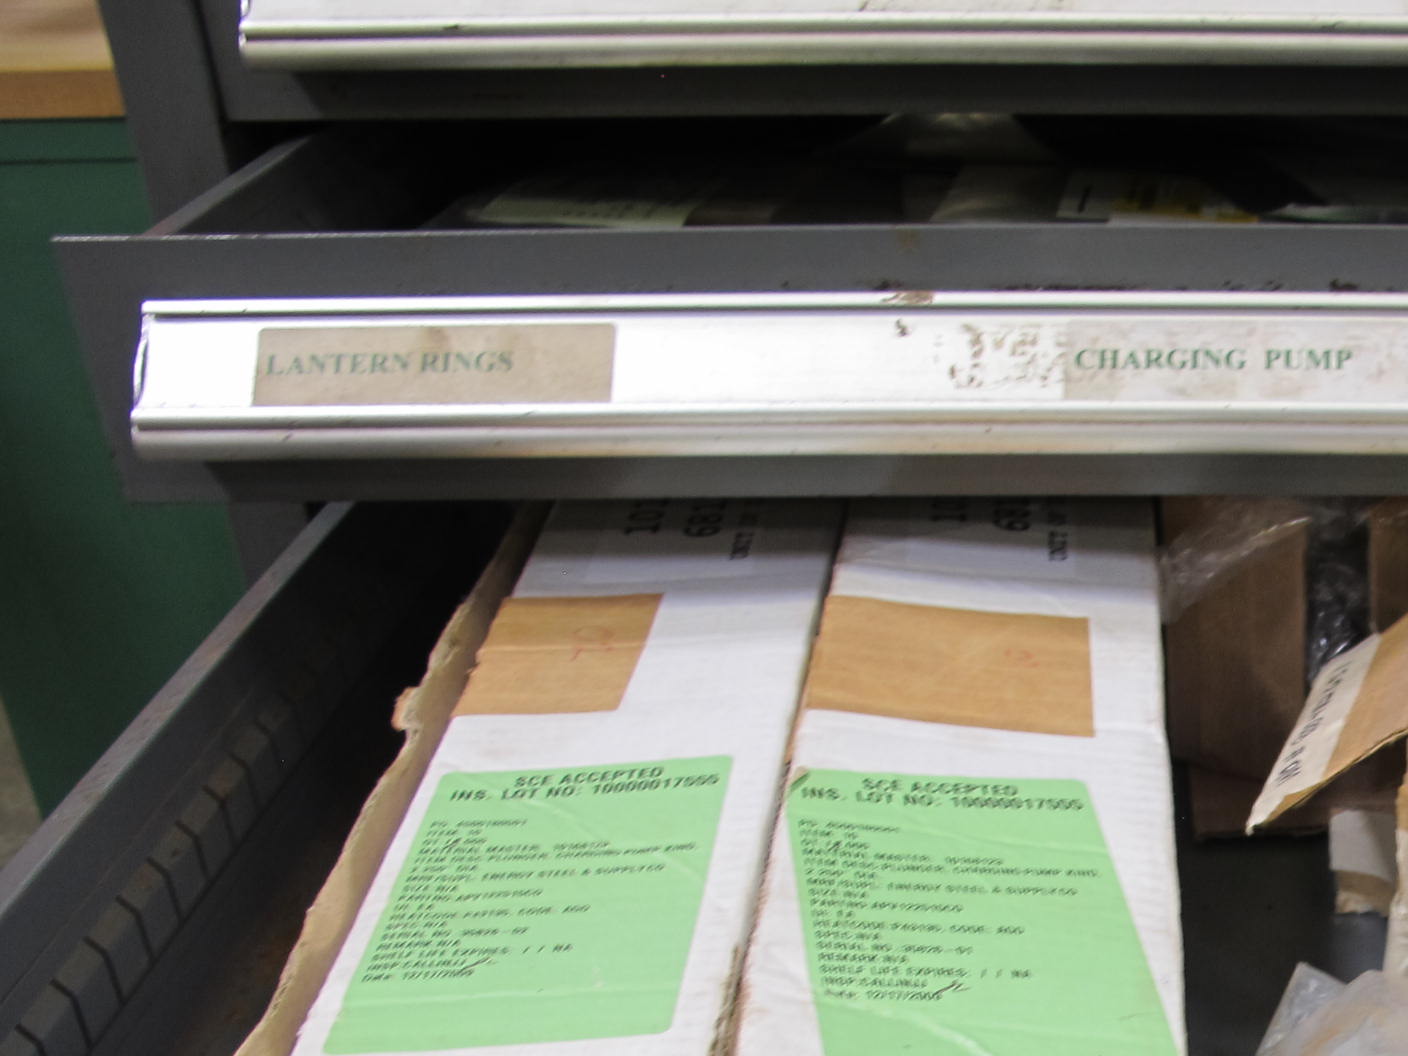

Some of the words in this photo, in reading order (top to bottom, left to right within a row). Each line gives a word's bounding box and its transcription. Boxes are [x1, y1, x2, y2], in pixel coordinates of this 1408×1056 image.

[265, 351, 410, 377] LANTERN
[418, 350, 514, 373] RINGS
[1074, 347, 1247, 371] CHARGING
[1263, 348, 1353, 371] PUMP
[560, 767, 664, 785] ACCEPTED
[911, 782, 1018, 796] ACCEPTED
